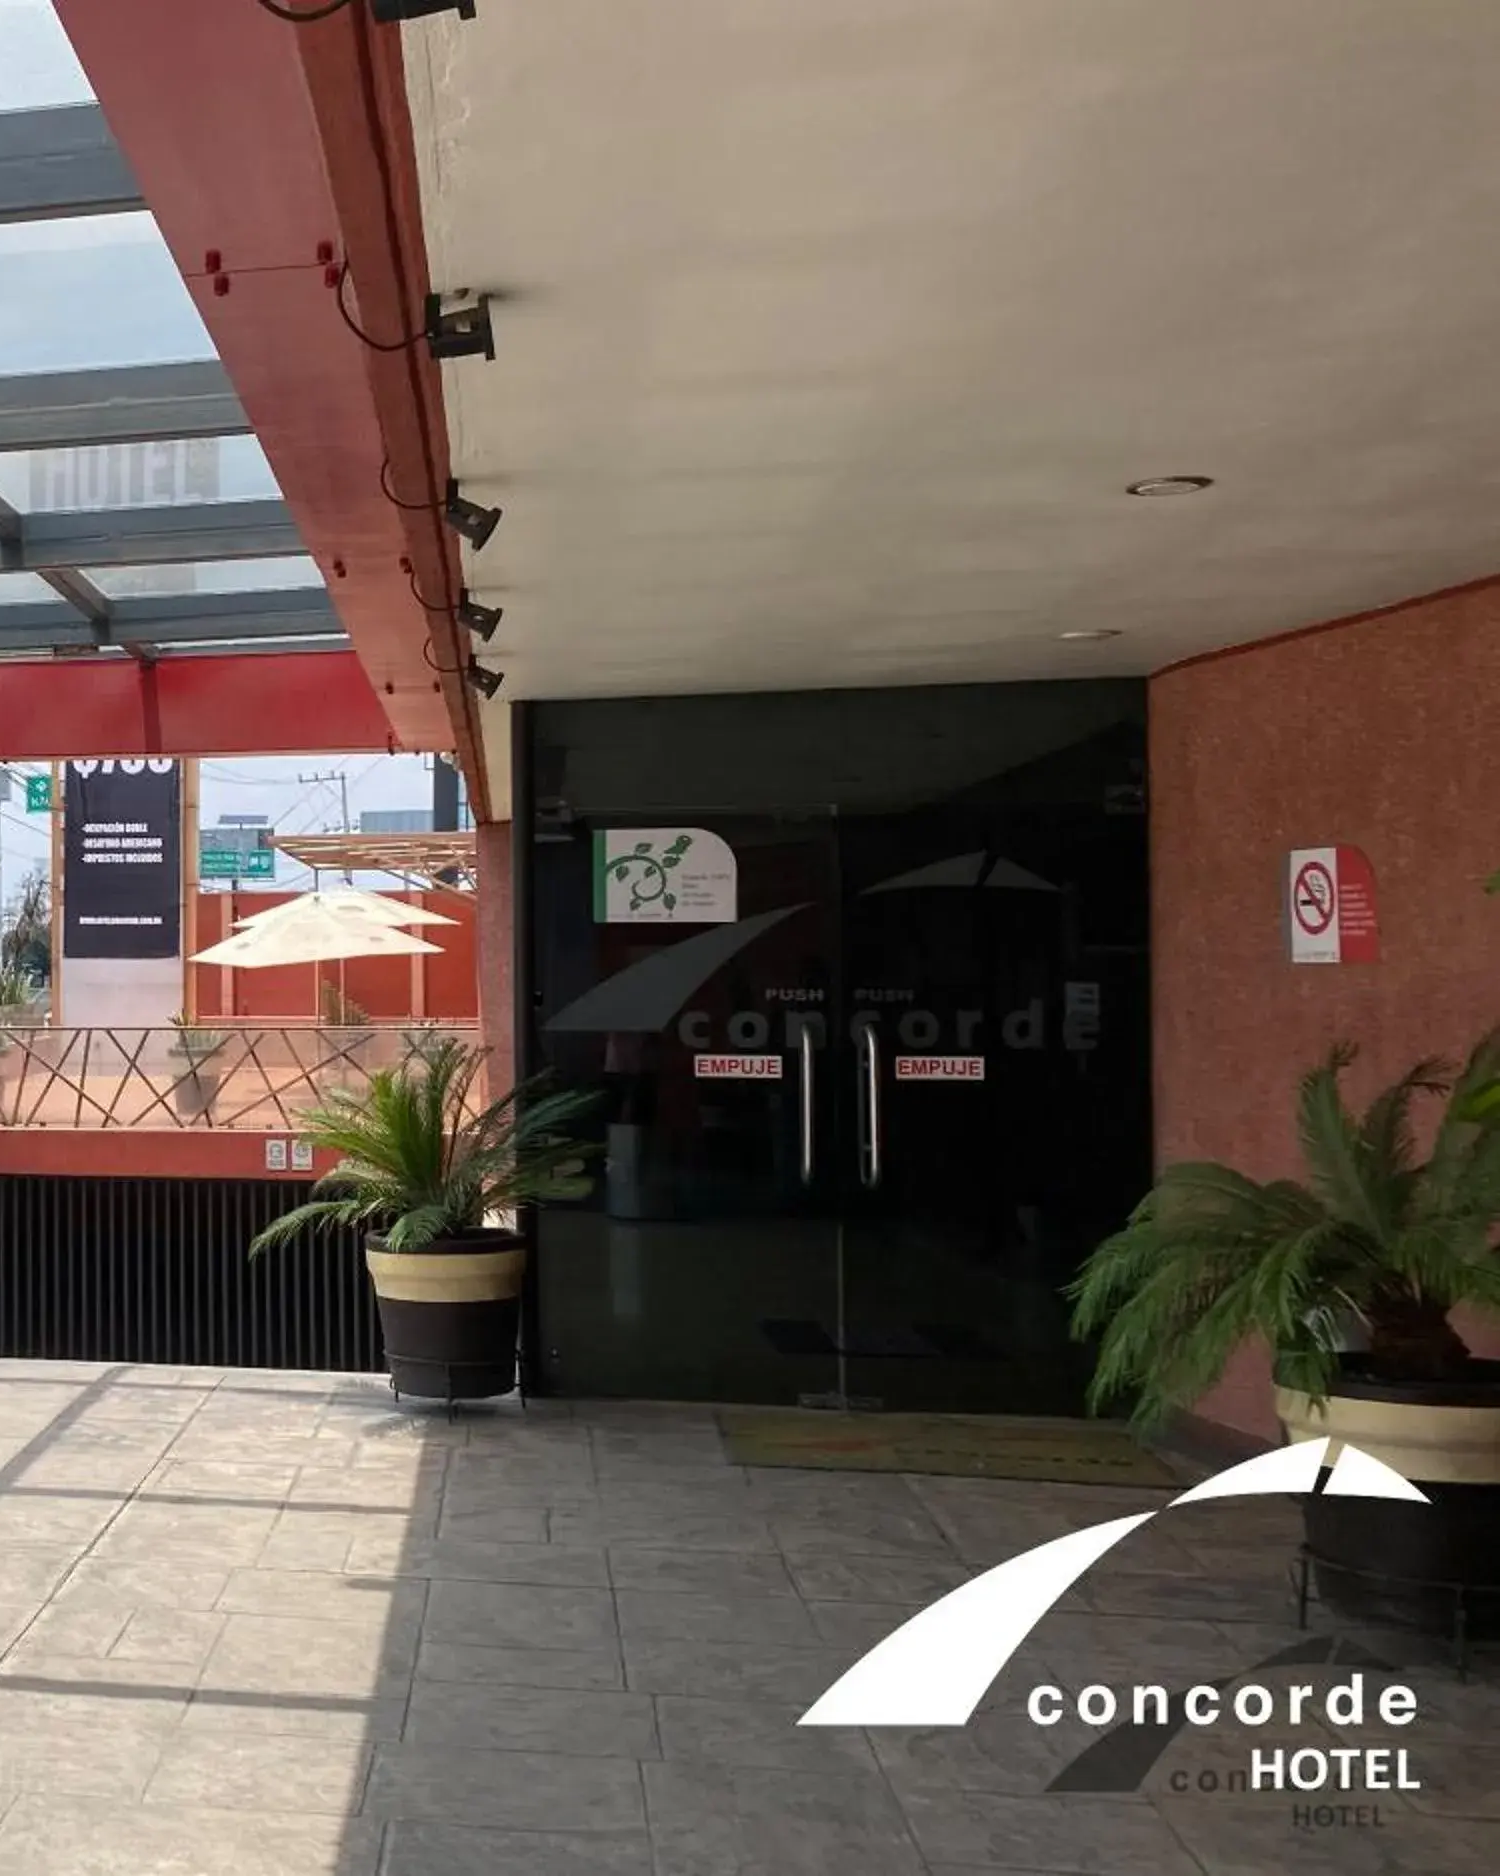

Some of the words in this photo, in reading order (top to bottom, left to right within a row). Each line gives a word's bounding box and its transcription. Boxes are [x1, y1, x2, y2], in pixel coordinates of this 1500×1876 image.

[765, 988, 825, 1002] PUSH
[697, 1058, 781, 1075] EMPUJE
[897, 1059, 982, 1077] EMPUJE
